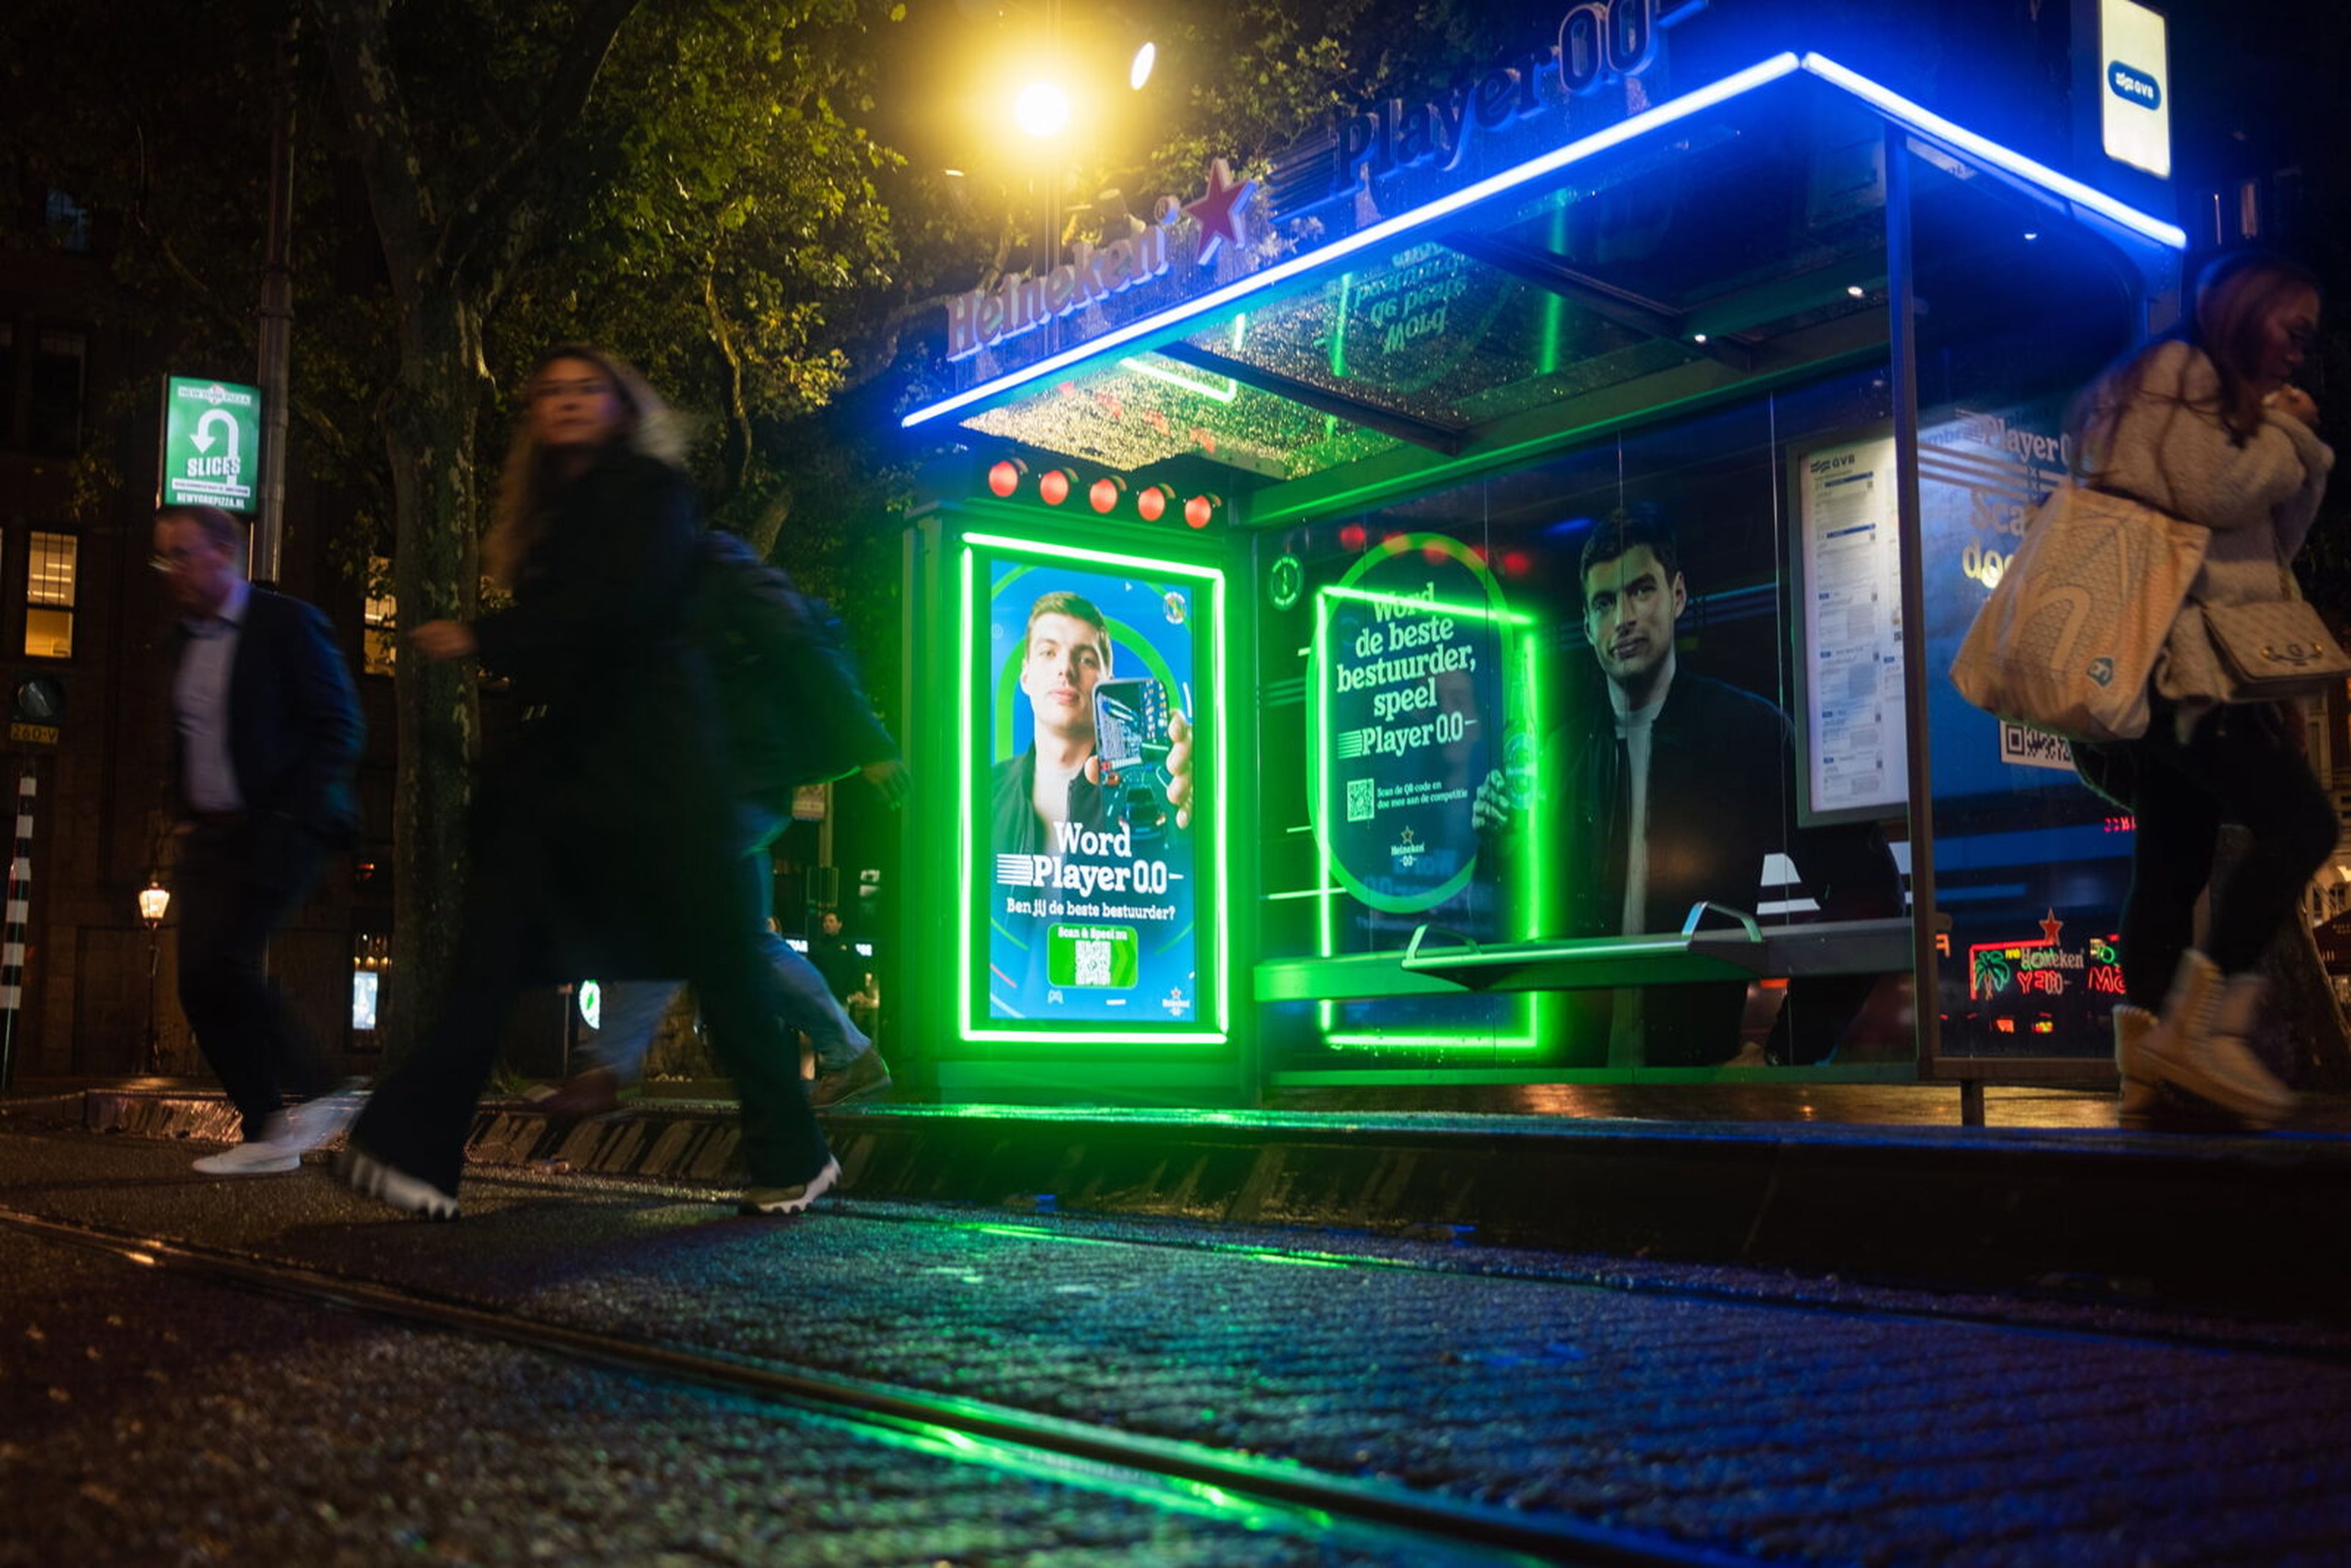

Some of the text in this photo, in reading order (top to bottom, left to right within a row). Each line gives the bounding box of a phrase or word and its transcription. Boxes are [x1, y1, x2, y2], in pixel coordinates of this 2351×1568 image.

[1335, 45, 1562, 191] Player
[946, 225, 1167, 361] Heineken
[1983, 415, 2058, 461] Player
[187, 456, 240, 477] SLICES
[1373, 582, 1435, 623] Word
[1355, 617, 1454, 658] de beste
[1337, 645, 1476, 692] bestuurder,
[1373, 677, 1437, 721] speel
[1361, 721, 1434, 757] Player
[1430, 787, 1468, 803] competitie
[1054, 822, 1132, 857] Word
[1032, 855, 1167, 898] Player 0.0
[1007, 898, 1176, 920] Ben jij de beste bestuurder?
